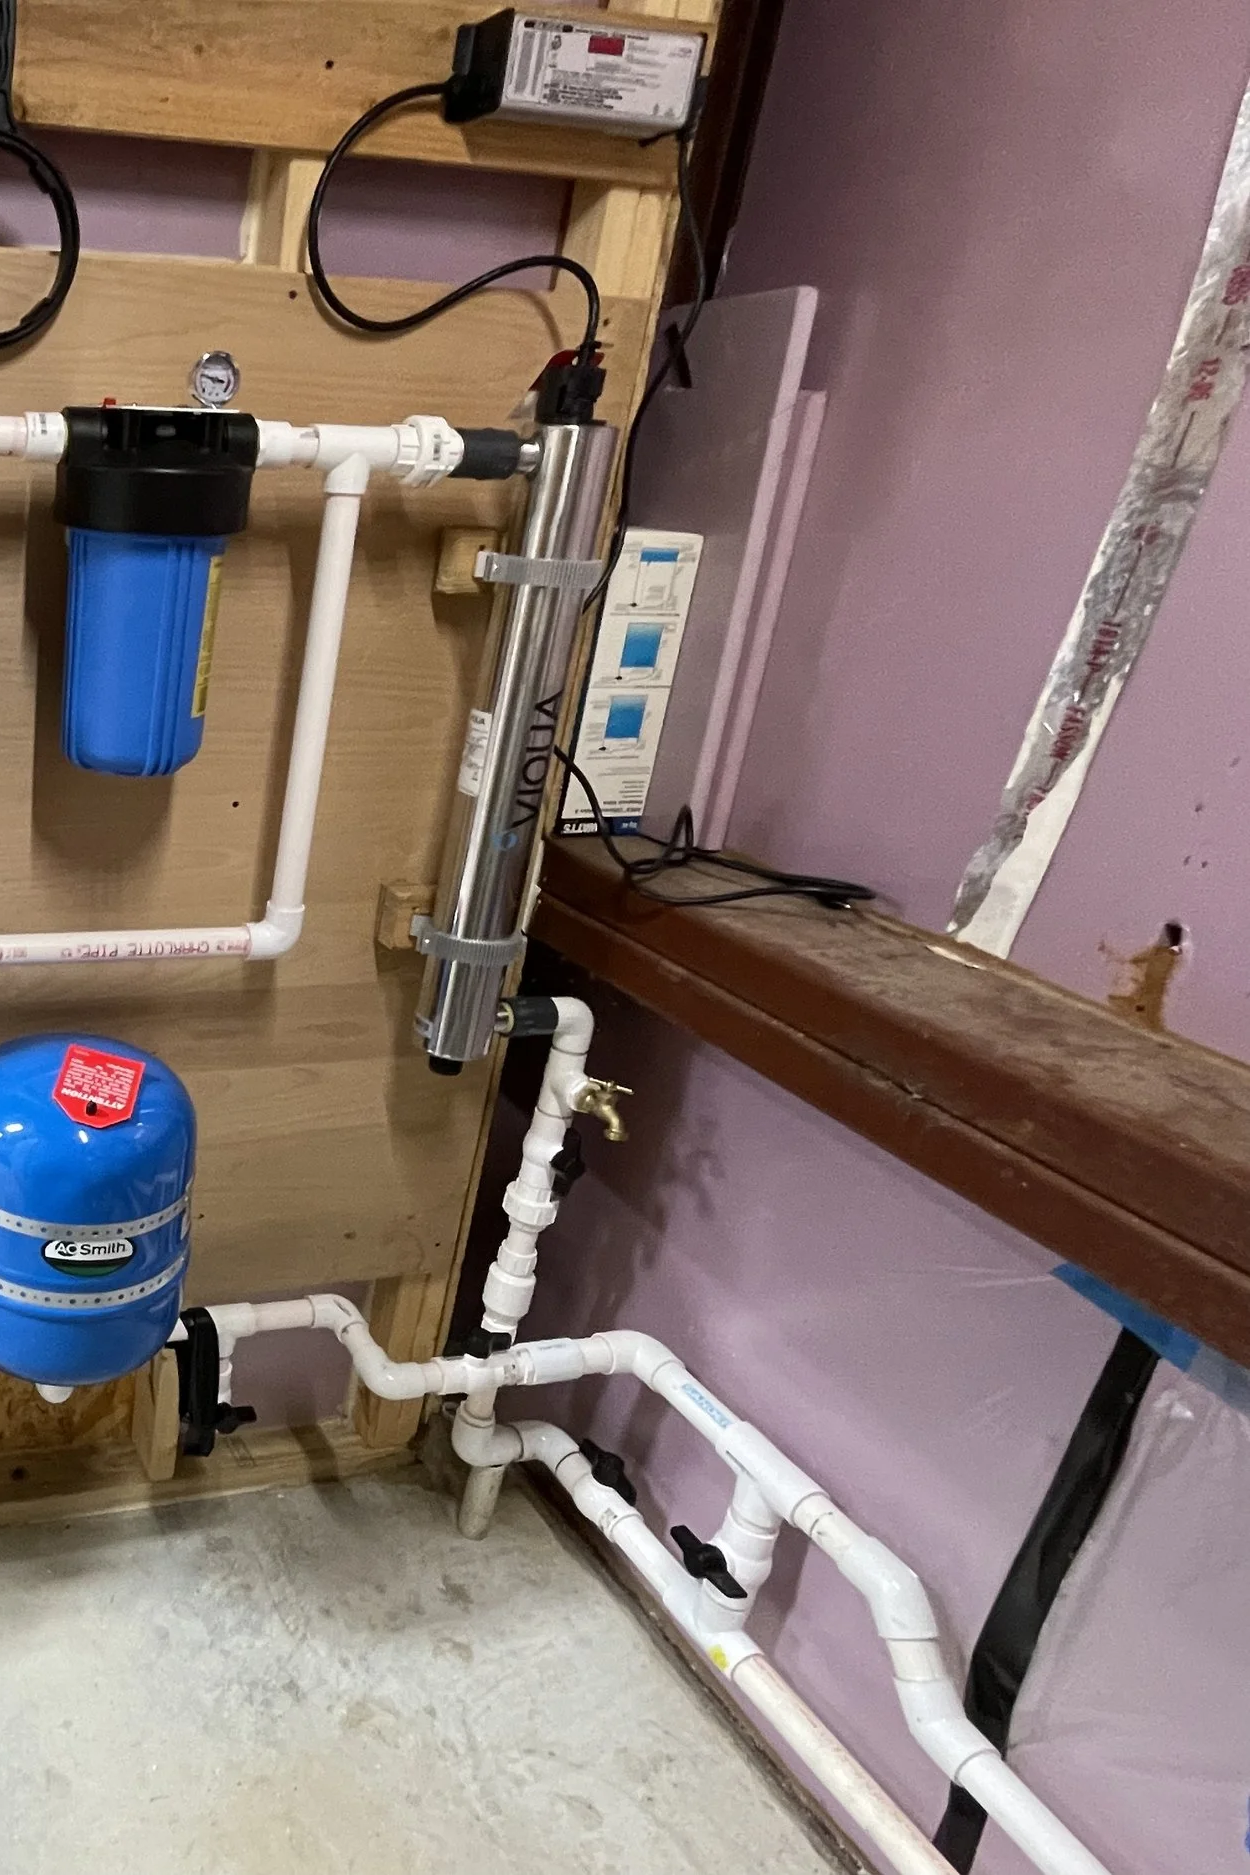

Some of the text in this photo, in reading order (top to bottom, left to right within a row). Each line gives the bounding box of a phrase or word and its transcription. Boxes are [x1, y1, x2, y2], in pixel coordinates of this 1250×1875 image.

[1050, 705, 1086, 760] FASSON
[127, 940, 210, 957] CHARLOTTE
[61, 1087, 126, 1110] ATTENTION
[79, 1242, 126, 1256] Smith
